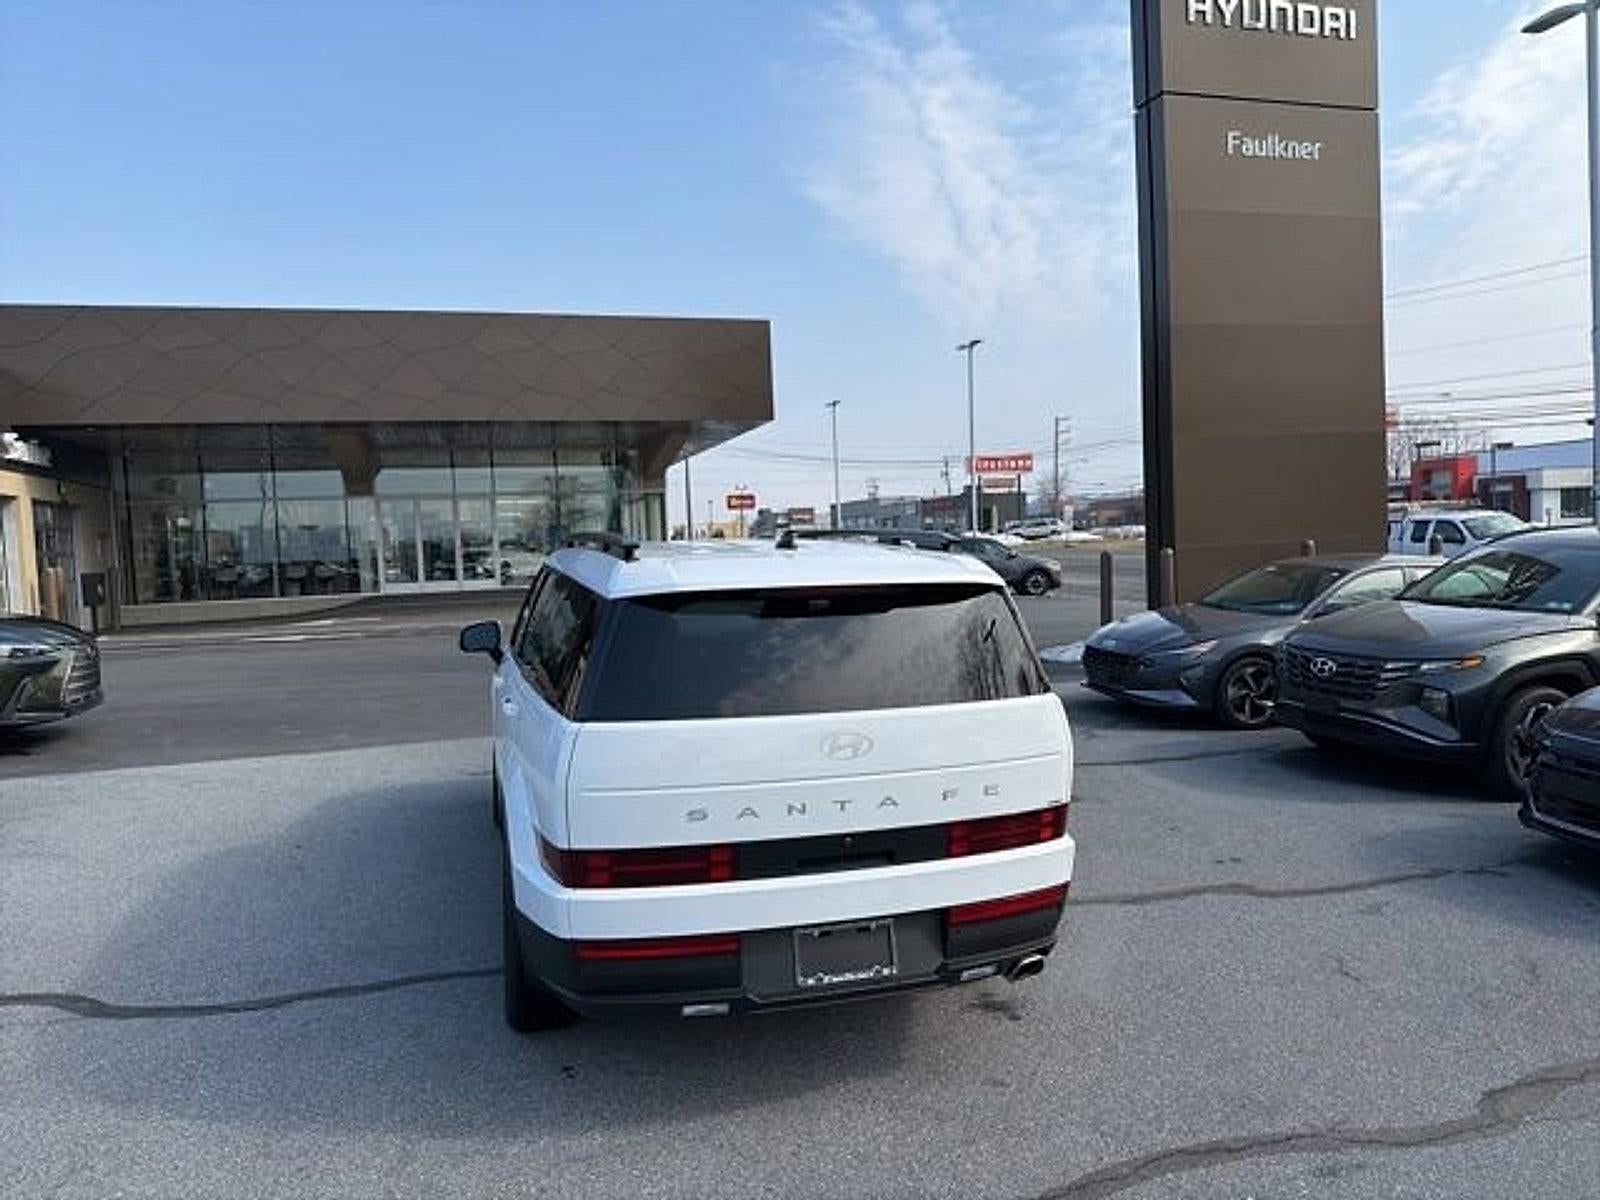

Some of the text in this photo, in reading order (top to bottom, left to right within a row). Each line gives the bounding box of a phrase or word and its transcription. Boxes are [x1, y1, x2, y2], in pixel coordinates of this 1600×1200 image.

[1187, 0, 1357, 40] HYUNDAI
[1226, 130, 1321, 160] Faulkner
[685, 783, 1002, 823] SANTA FE
